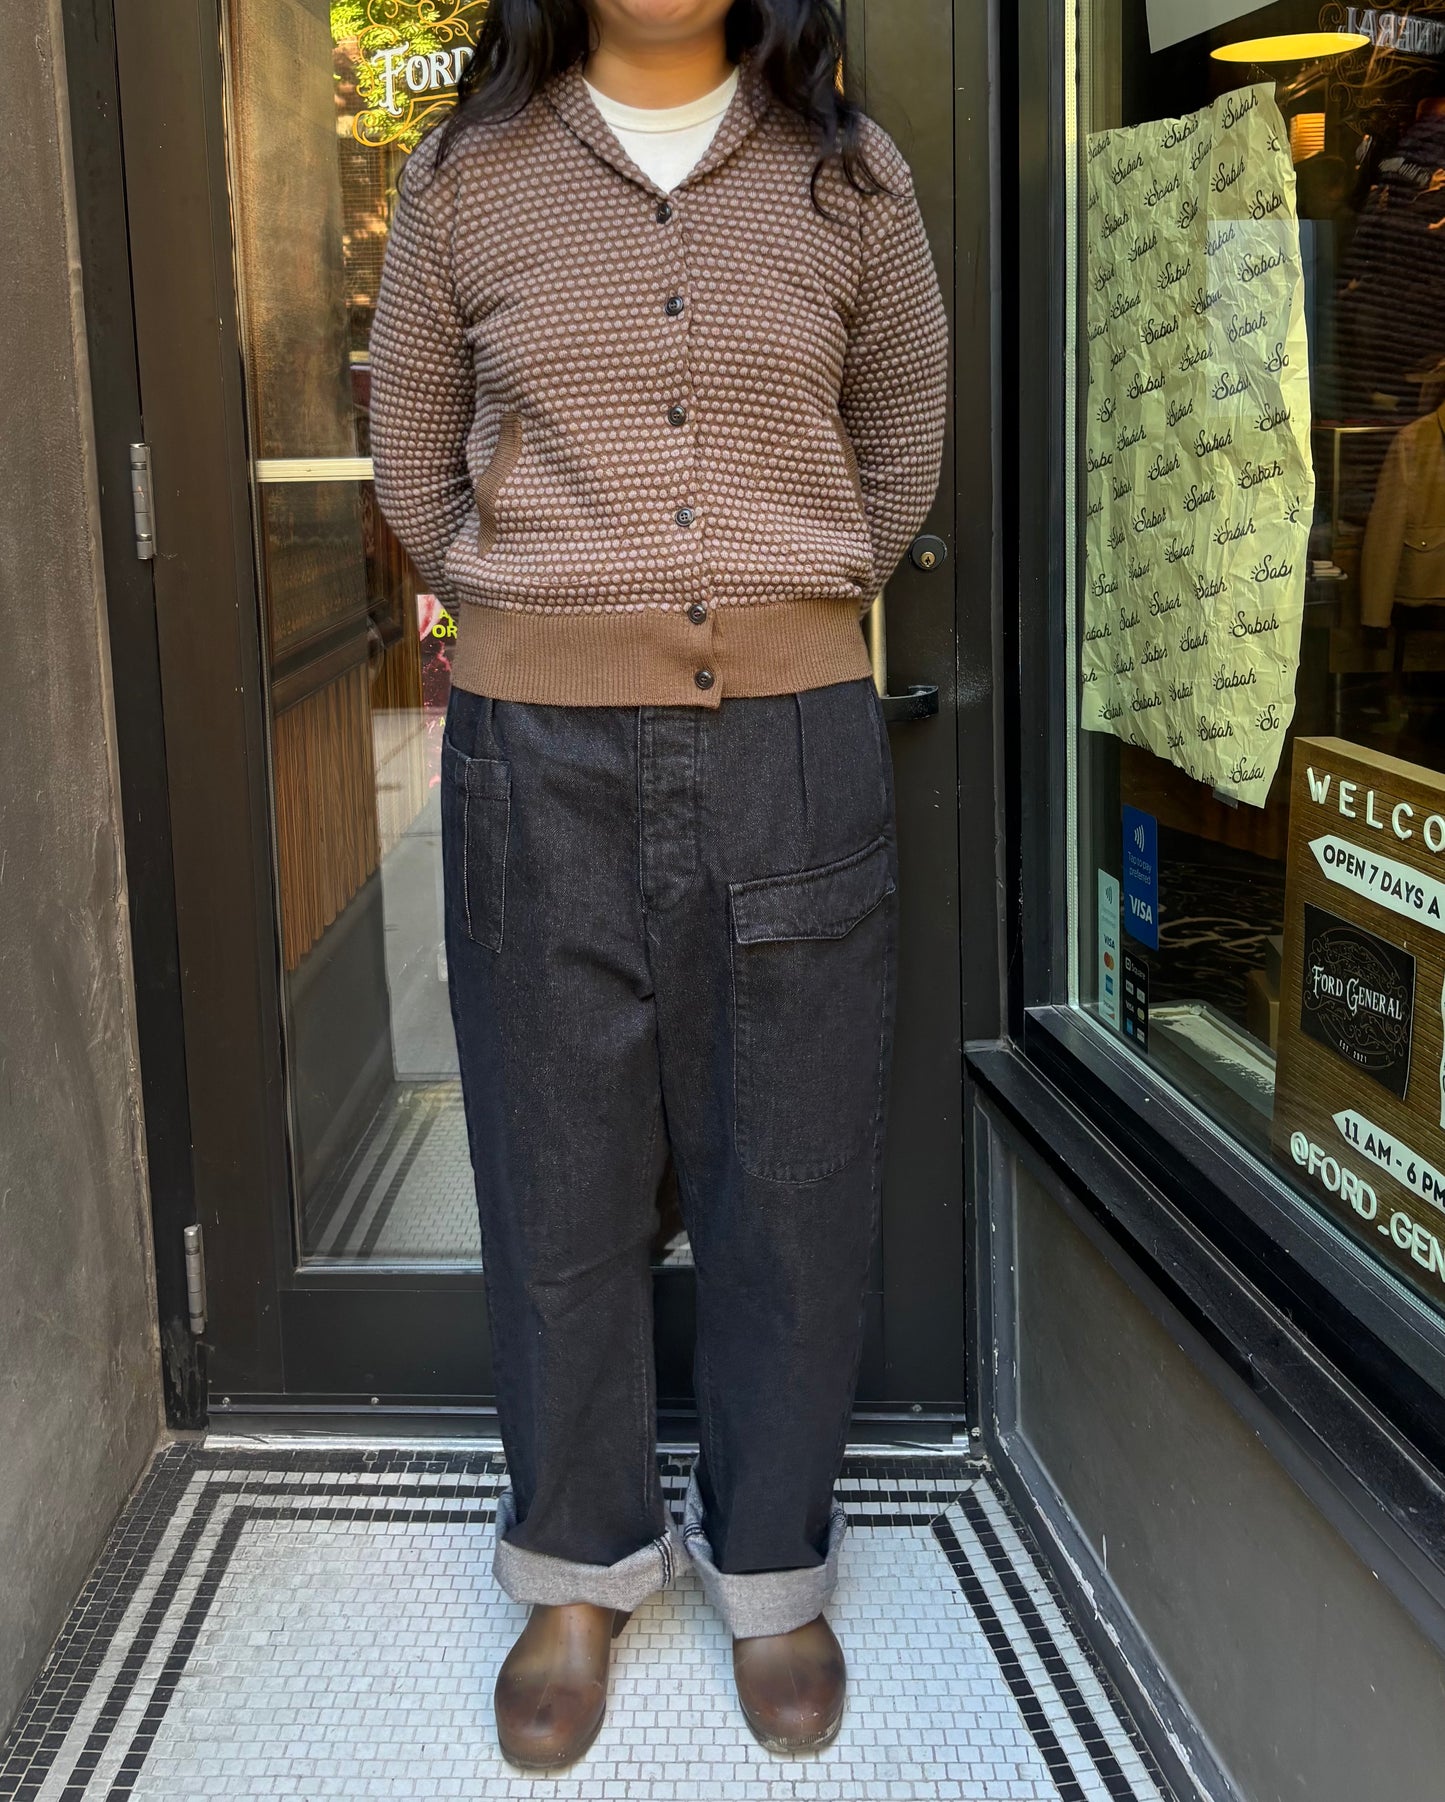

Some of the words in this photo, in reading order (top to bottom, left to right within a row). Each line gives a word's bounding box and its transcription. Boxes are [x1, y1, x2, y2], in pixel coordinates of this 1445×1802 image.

[1224, 88, 1258, 129] Sabah
[1113, 152, 1144, 185] Sabah
[1242, 246, 1287, 283] Sabah
[1112, 290, 1141, 319] Sabah
[1144, 315, 1179, 345] Sabah
[1228, 310, 1268, 343] Sabah
[1130, 371, 1166, 399] Sabah
[1196, 428, 1233, 458] Sabah
[1150, 453, 1180, 480] Sabah
[1241, 461, 1284, 489] Sabah
[1134, 507, 1167, 532] Sabah
[1217, 517, 1256, 545] Sabah
[1195, 575, 1227, 600] Sabah
[1150, 591, 1181, 616] Sabah
[1232, 610, 1279, 638] Sabah
[1215, 663, 1256, 691] Sabah
[1200, 715, 1233, 742] Sabah
[1306, 767, 1445, 853] WELCO
[1323, 845, 1366, 880] OPEN
[1368, 864, 1379, 885] 7
[1380, 871, 1424, 909] DAYS
[1428, 896, 1441, 919] A
[1129, 894, 1153, 925] VISA
[1104, 934, 1115, 950] VISA
[1312, 965, 1343, 999] FORD
[1346, 977, 1403, 1021] GENERAL
[1353, 1050, 1368, 1063] 2021
[1344, 1117, 1360, 1146] 11
[1364, 1133, 1392, 1166] AM
[1406, 1162, 1416, 1185] 6
